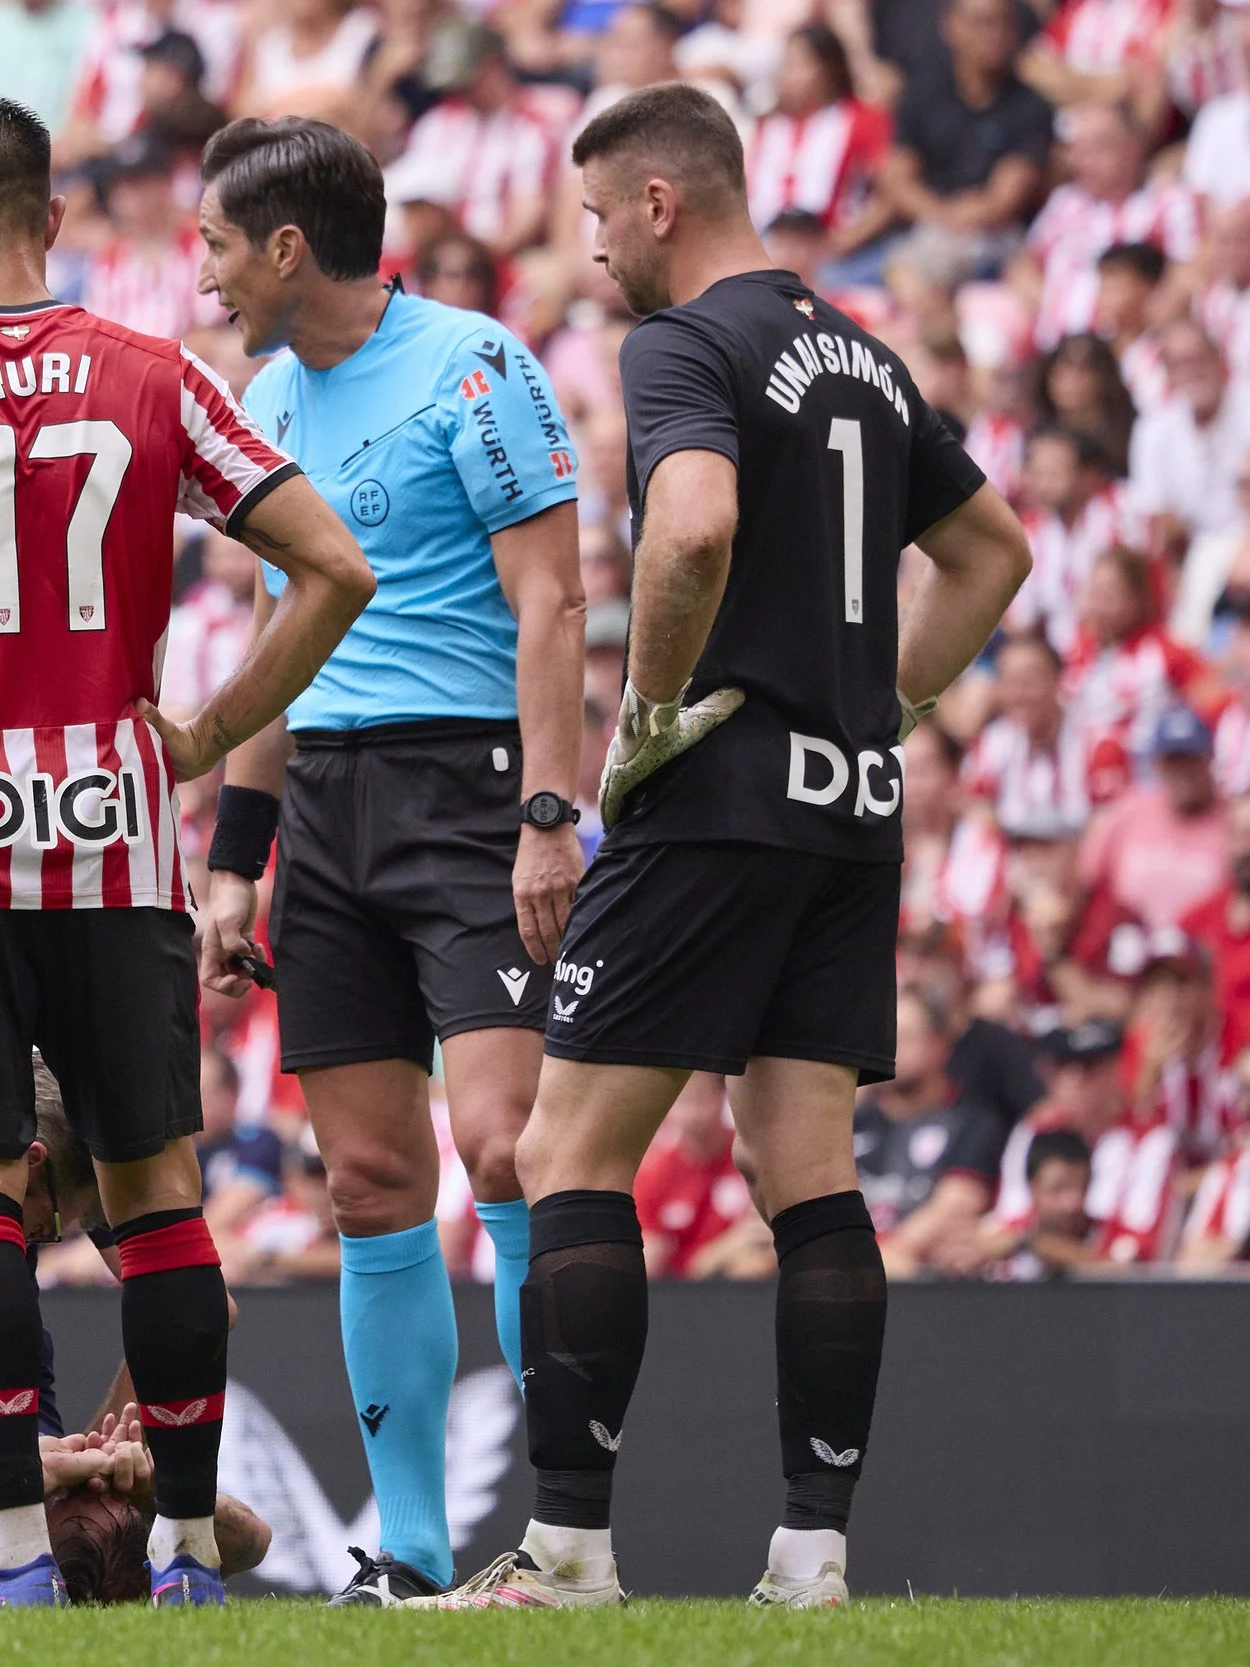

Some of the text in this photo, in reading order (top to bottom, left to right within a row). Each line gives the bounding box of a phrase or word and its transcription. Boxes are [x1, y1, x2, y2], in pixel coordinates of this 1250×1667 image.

[514, 355, 560, 446] WÜRTH
[473, 401, 524, 503] WÜRTH
[827, 417, 865, 624] 1
